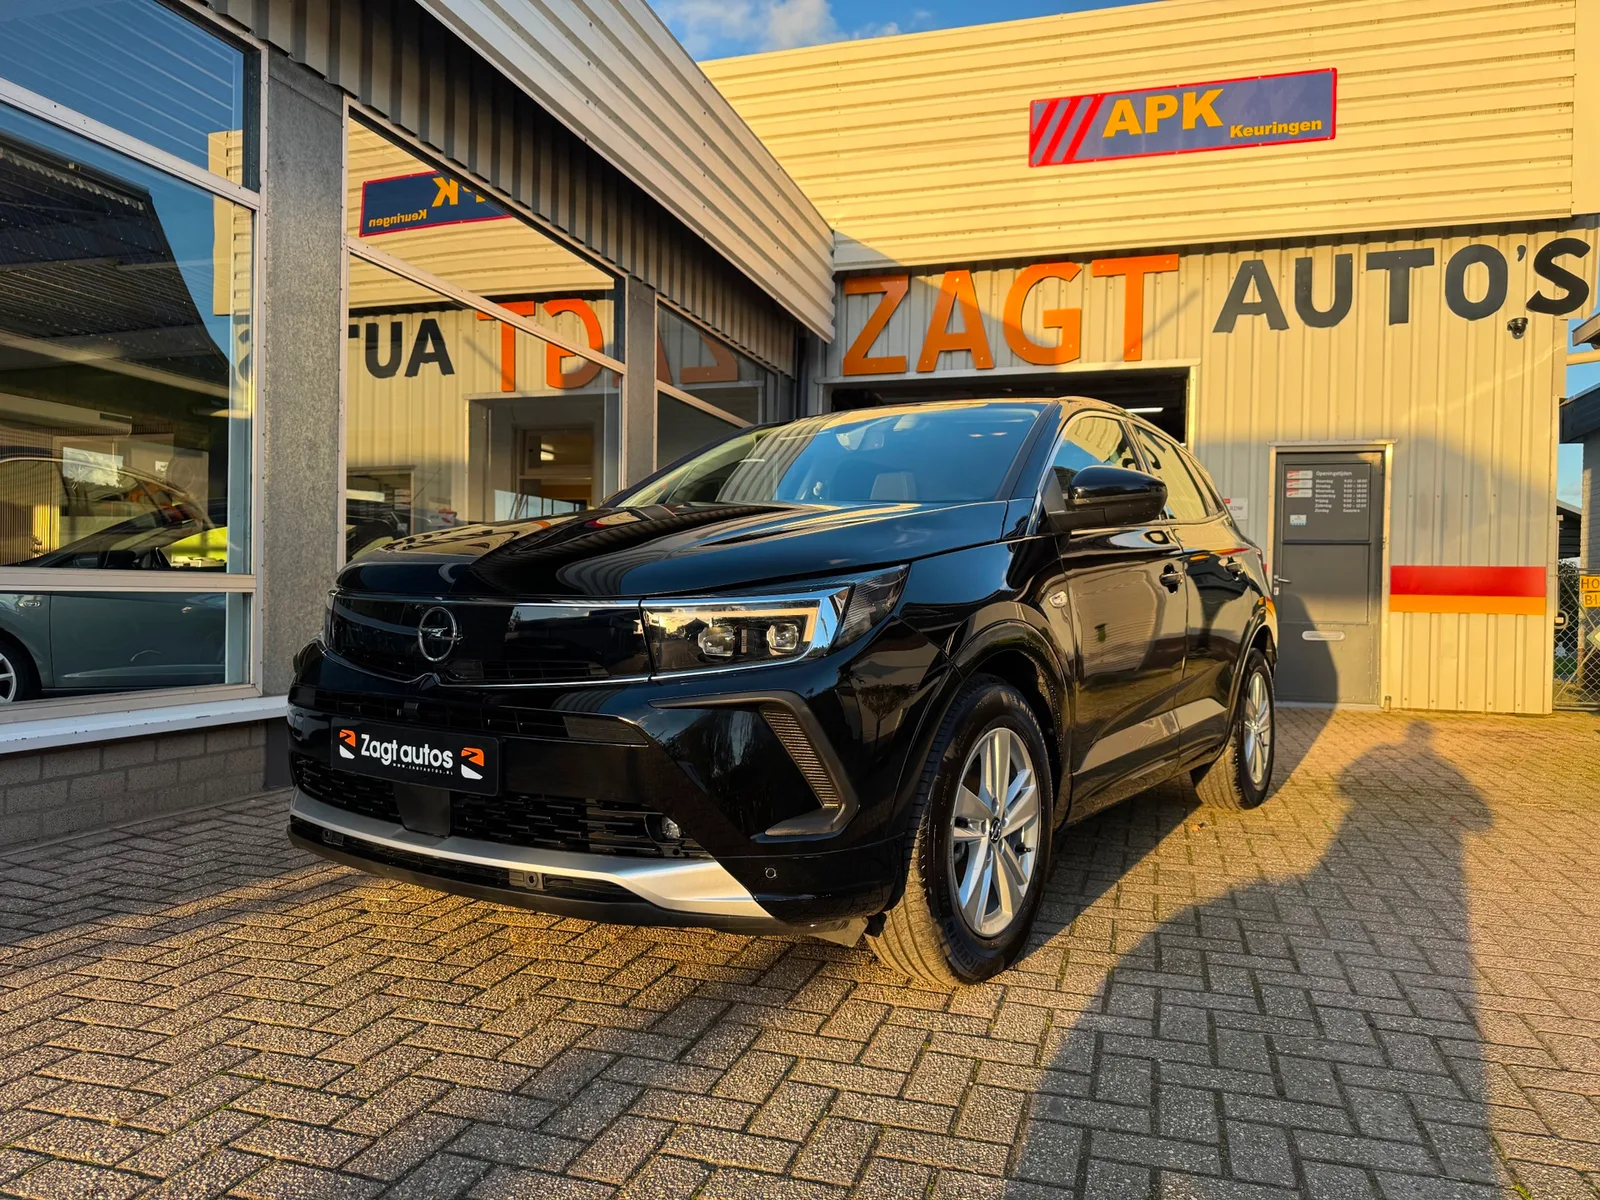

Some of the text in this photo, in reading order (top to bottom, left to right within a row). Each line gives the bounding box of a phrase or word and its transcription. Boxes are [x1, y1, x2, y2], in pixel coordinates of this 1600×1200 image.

[1102, 88, 1224, 138] APK
[1229, 118, 1322, 139] Keuringen
[842, 237, 1592, 376] ZAGT AUTO'S
[361, 733, 454, 769] Zagt autos
